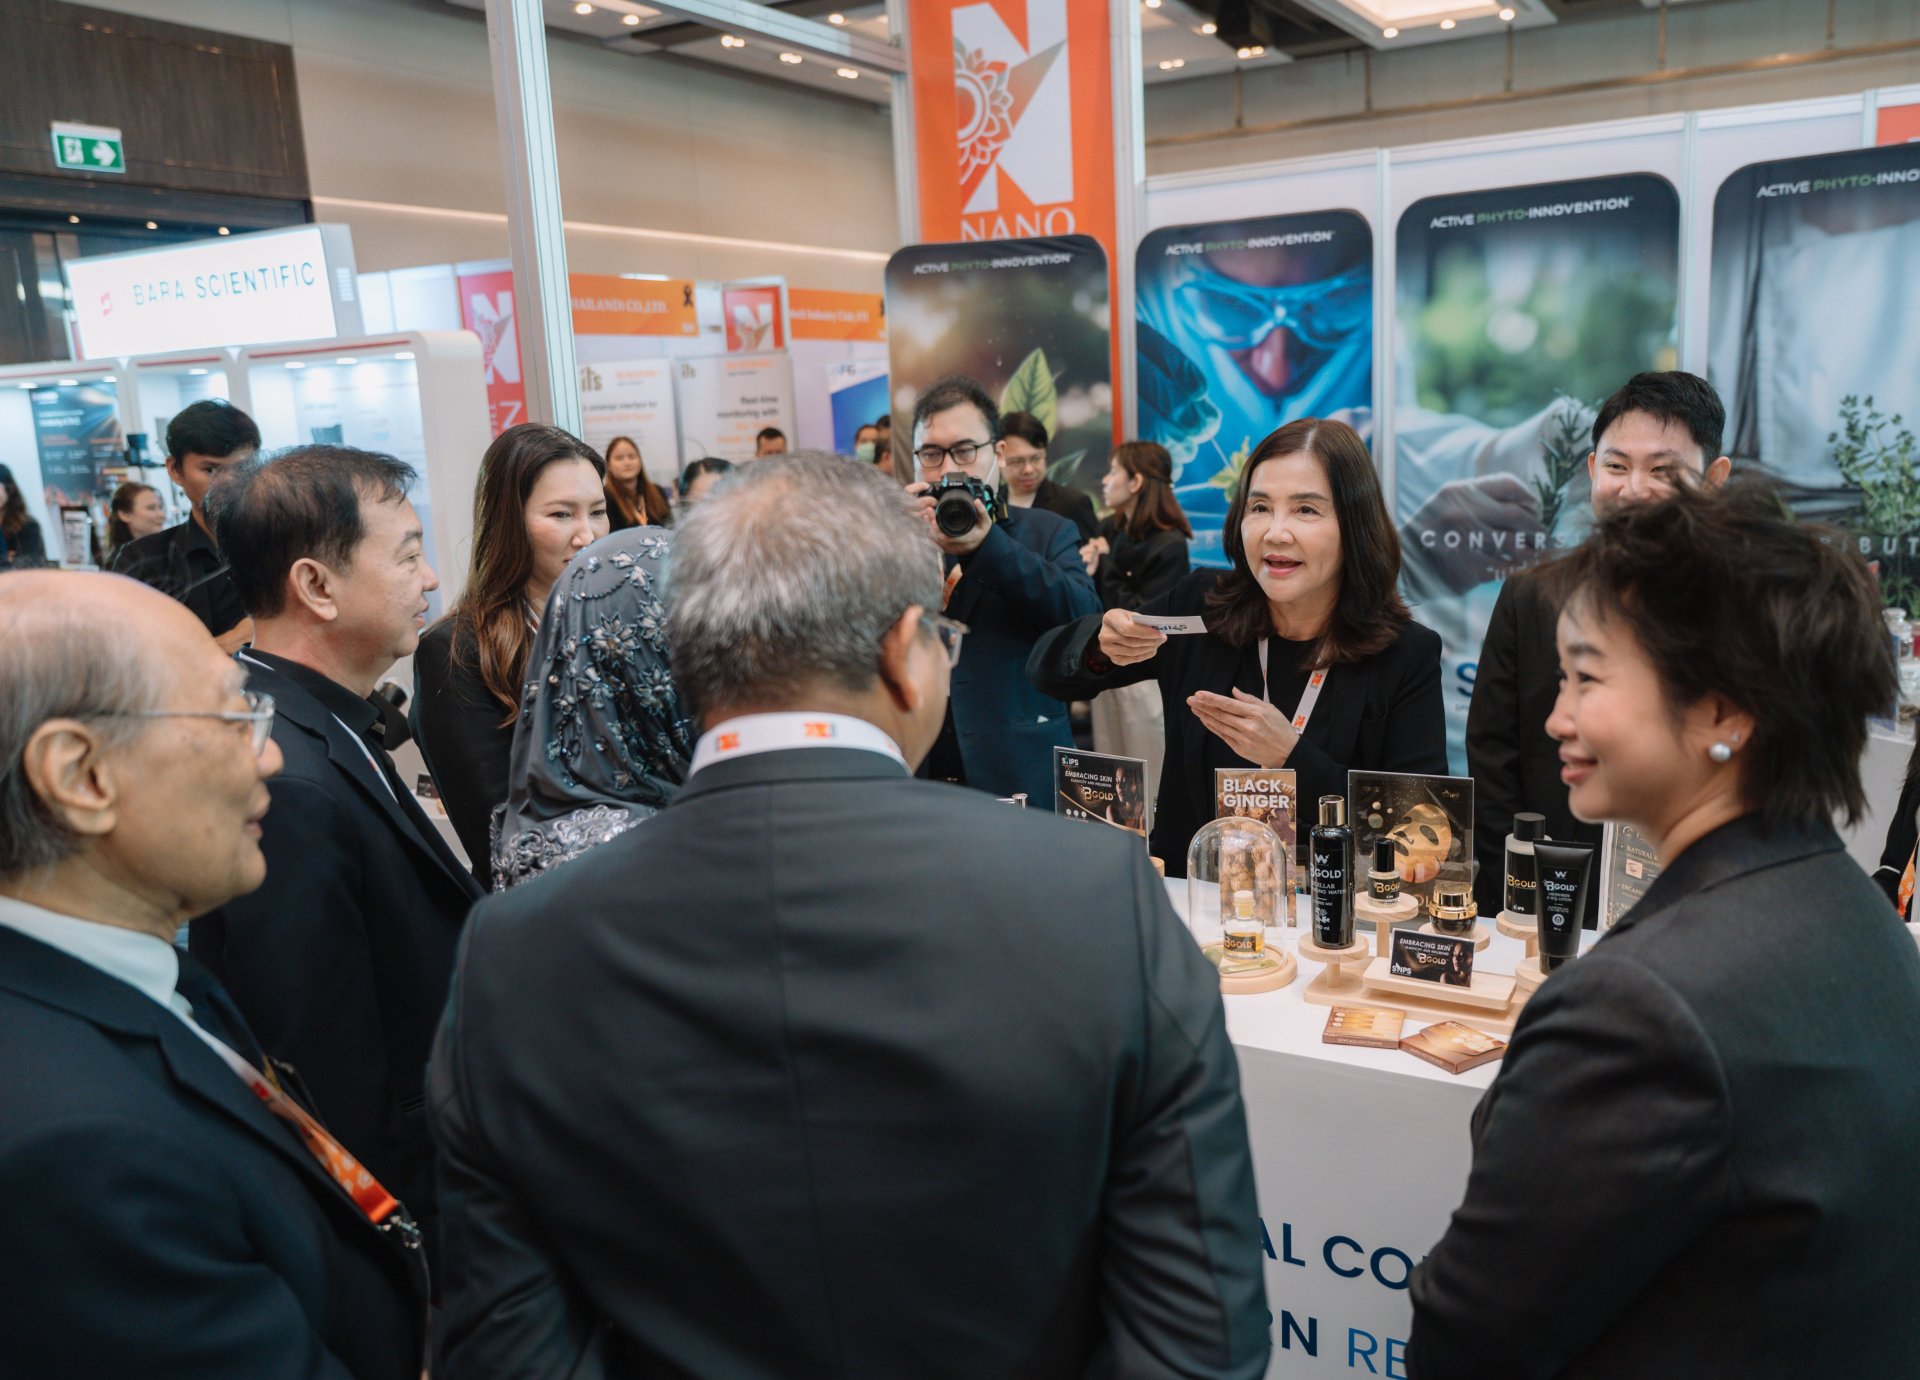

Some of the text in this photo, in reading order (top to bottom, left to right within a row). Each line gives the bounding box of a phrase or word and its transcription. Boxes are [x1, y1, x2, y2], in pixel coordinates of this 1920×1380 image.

[1756, 180, 1810, 198] ACTIVE
[960, 207, 1076, 241] NANO
[1429, 213, 1475, 229] ACTIVE
[1165, 243, 1203, 256] ACTIVE
[913, 261, 950, 275] ACTIVE
[132, 261, 316, 306] BARA SCIENTIFIC
[1064, 770, 1113, 783] EMBRACING SKIN
[1223, 778, 1282, 793] BLACK
[1223, 794, 1290, 809] GINGER
[1626, 846, 1653, 859] NATURAL
[1400, 938, 1435, 950] EMBRACING
[1322, 1235, 1429, 1290] CO
